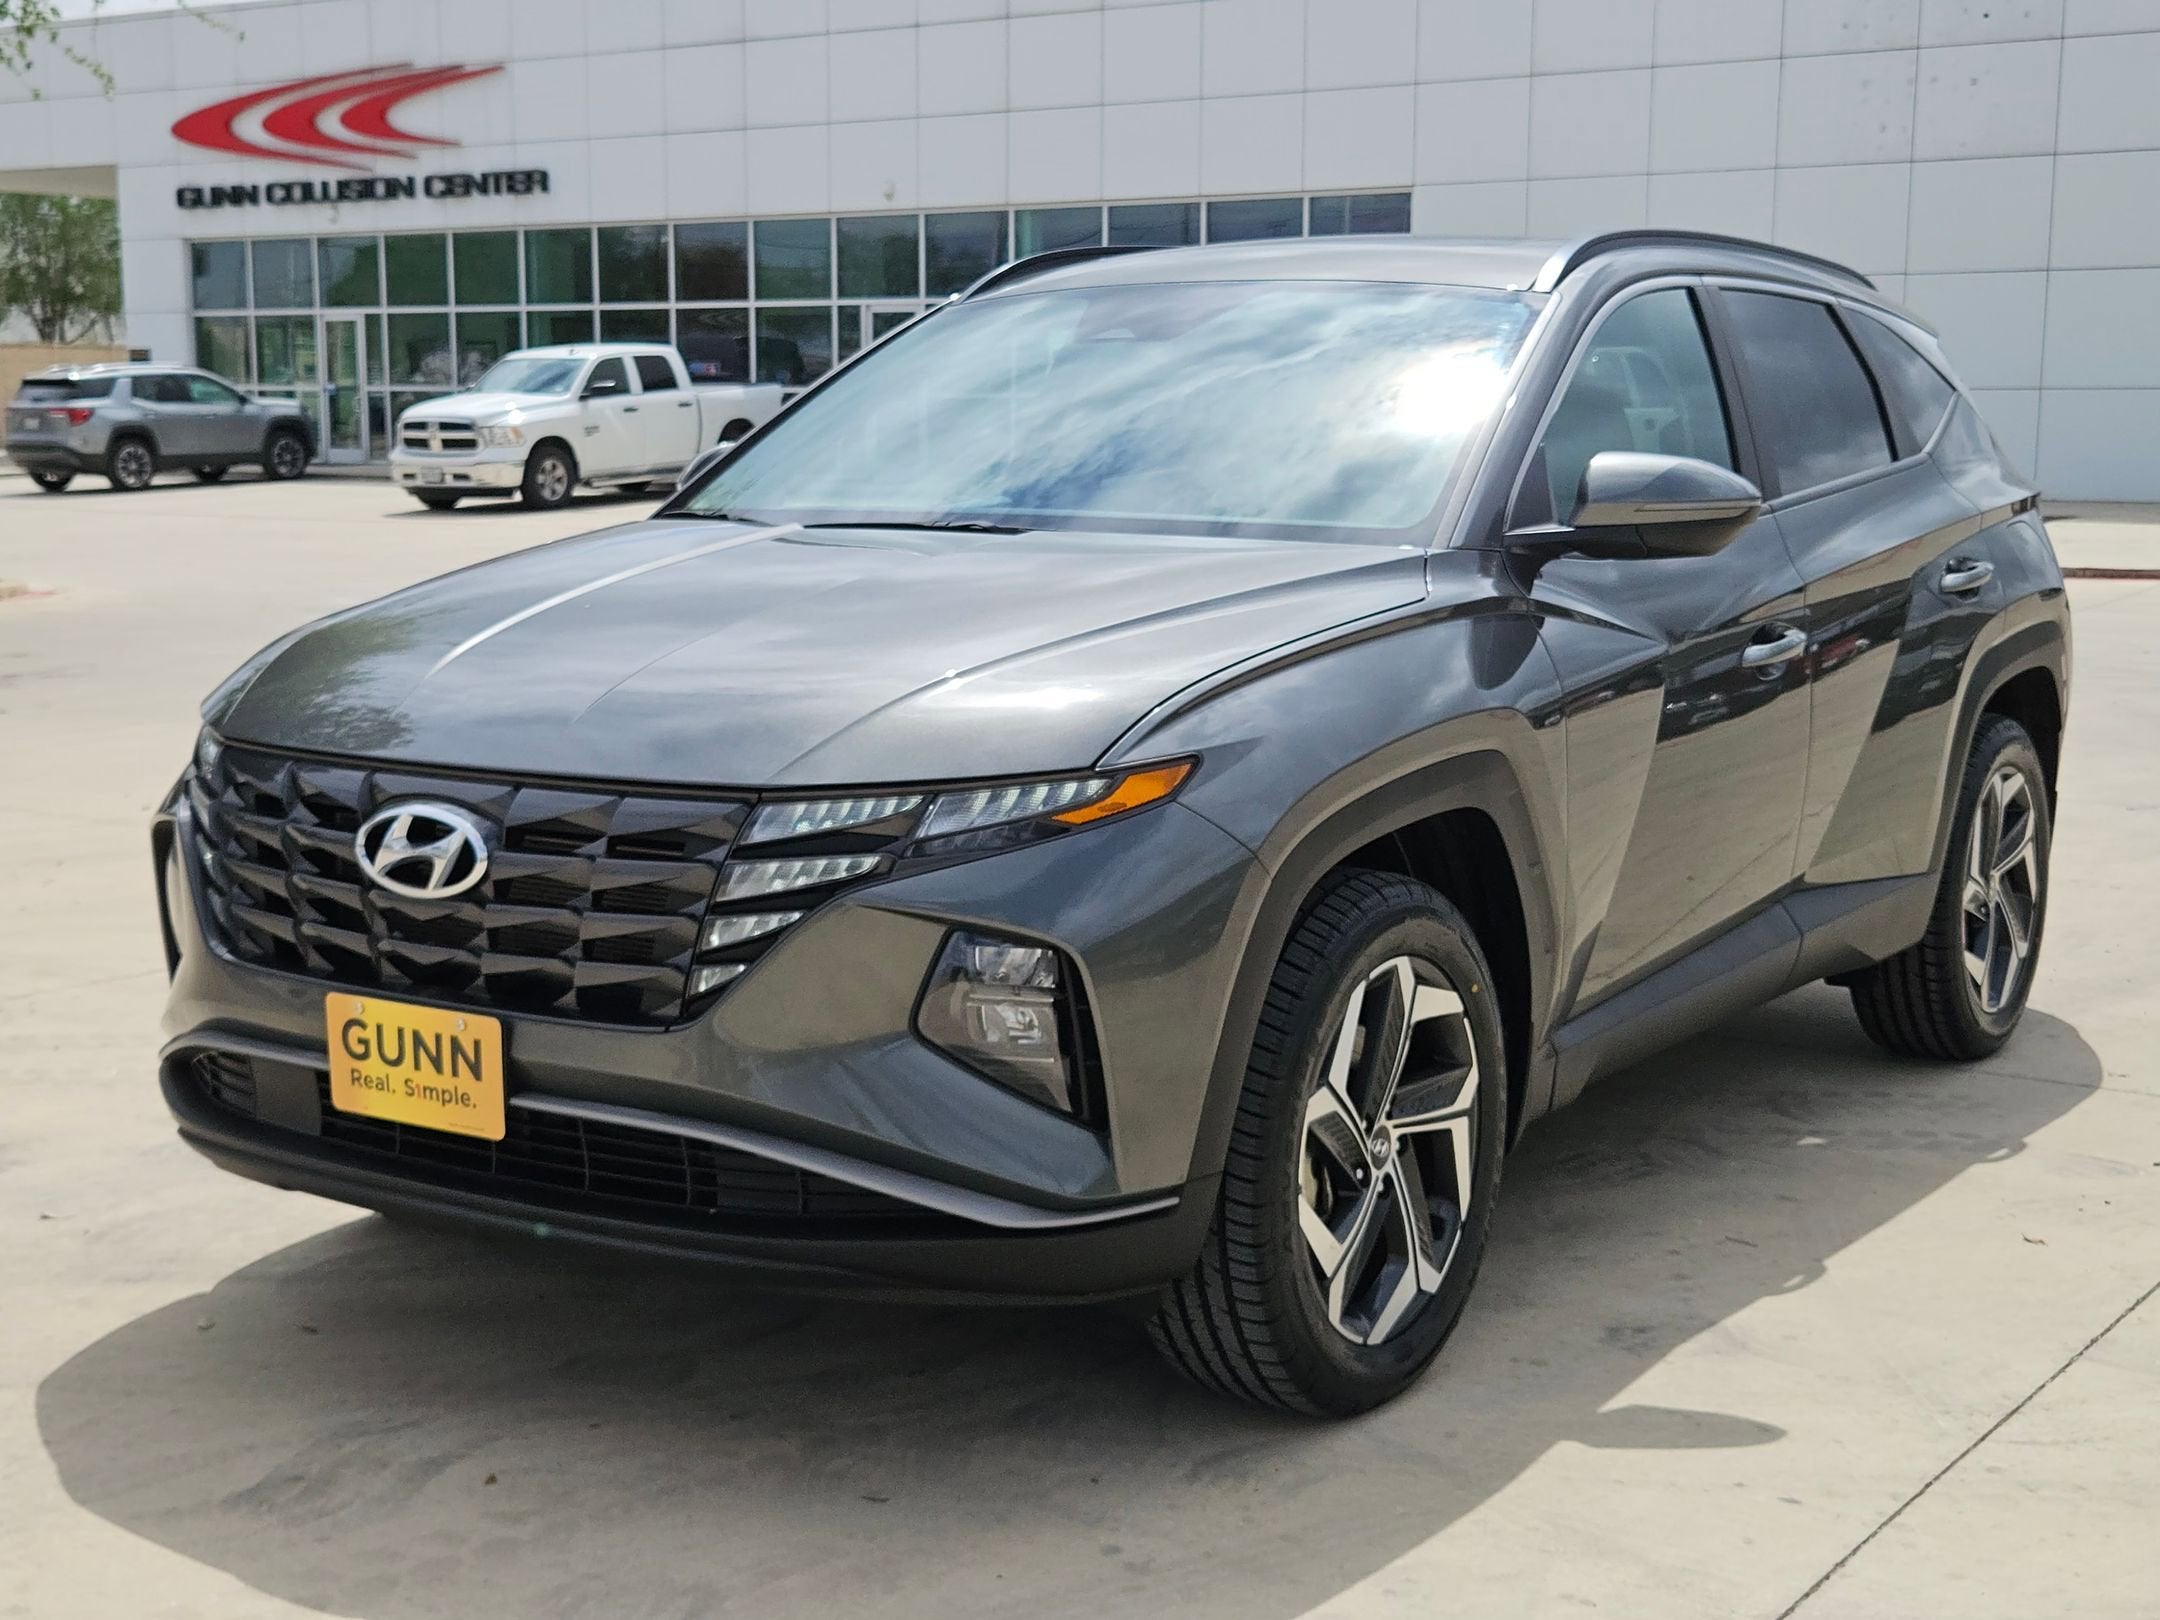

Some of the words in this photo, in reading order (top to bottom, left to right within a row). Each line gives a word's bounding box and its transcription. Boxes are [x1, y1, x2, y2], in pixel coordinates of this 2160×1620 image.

[176, 184, 260, 209] GUNN
[265, 176, 416, 205] COLLISION
[423, 169, 550, 199] CENTER
[341, 1017, 483, 1082] GUNN
[350, 1067, 397, 1094] Real.
